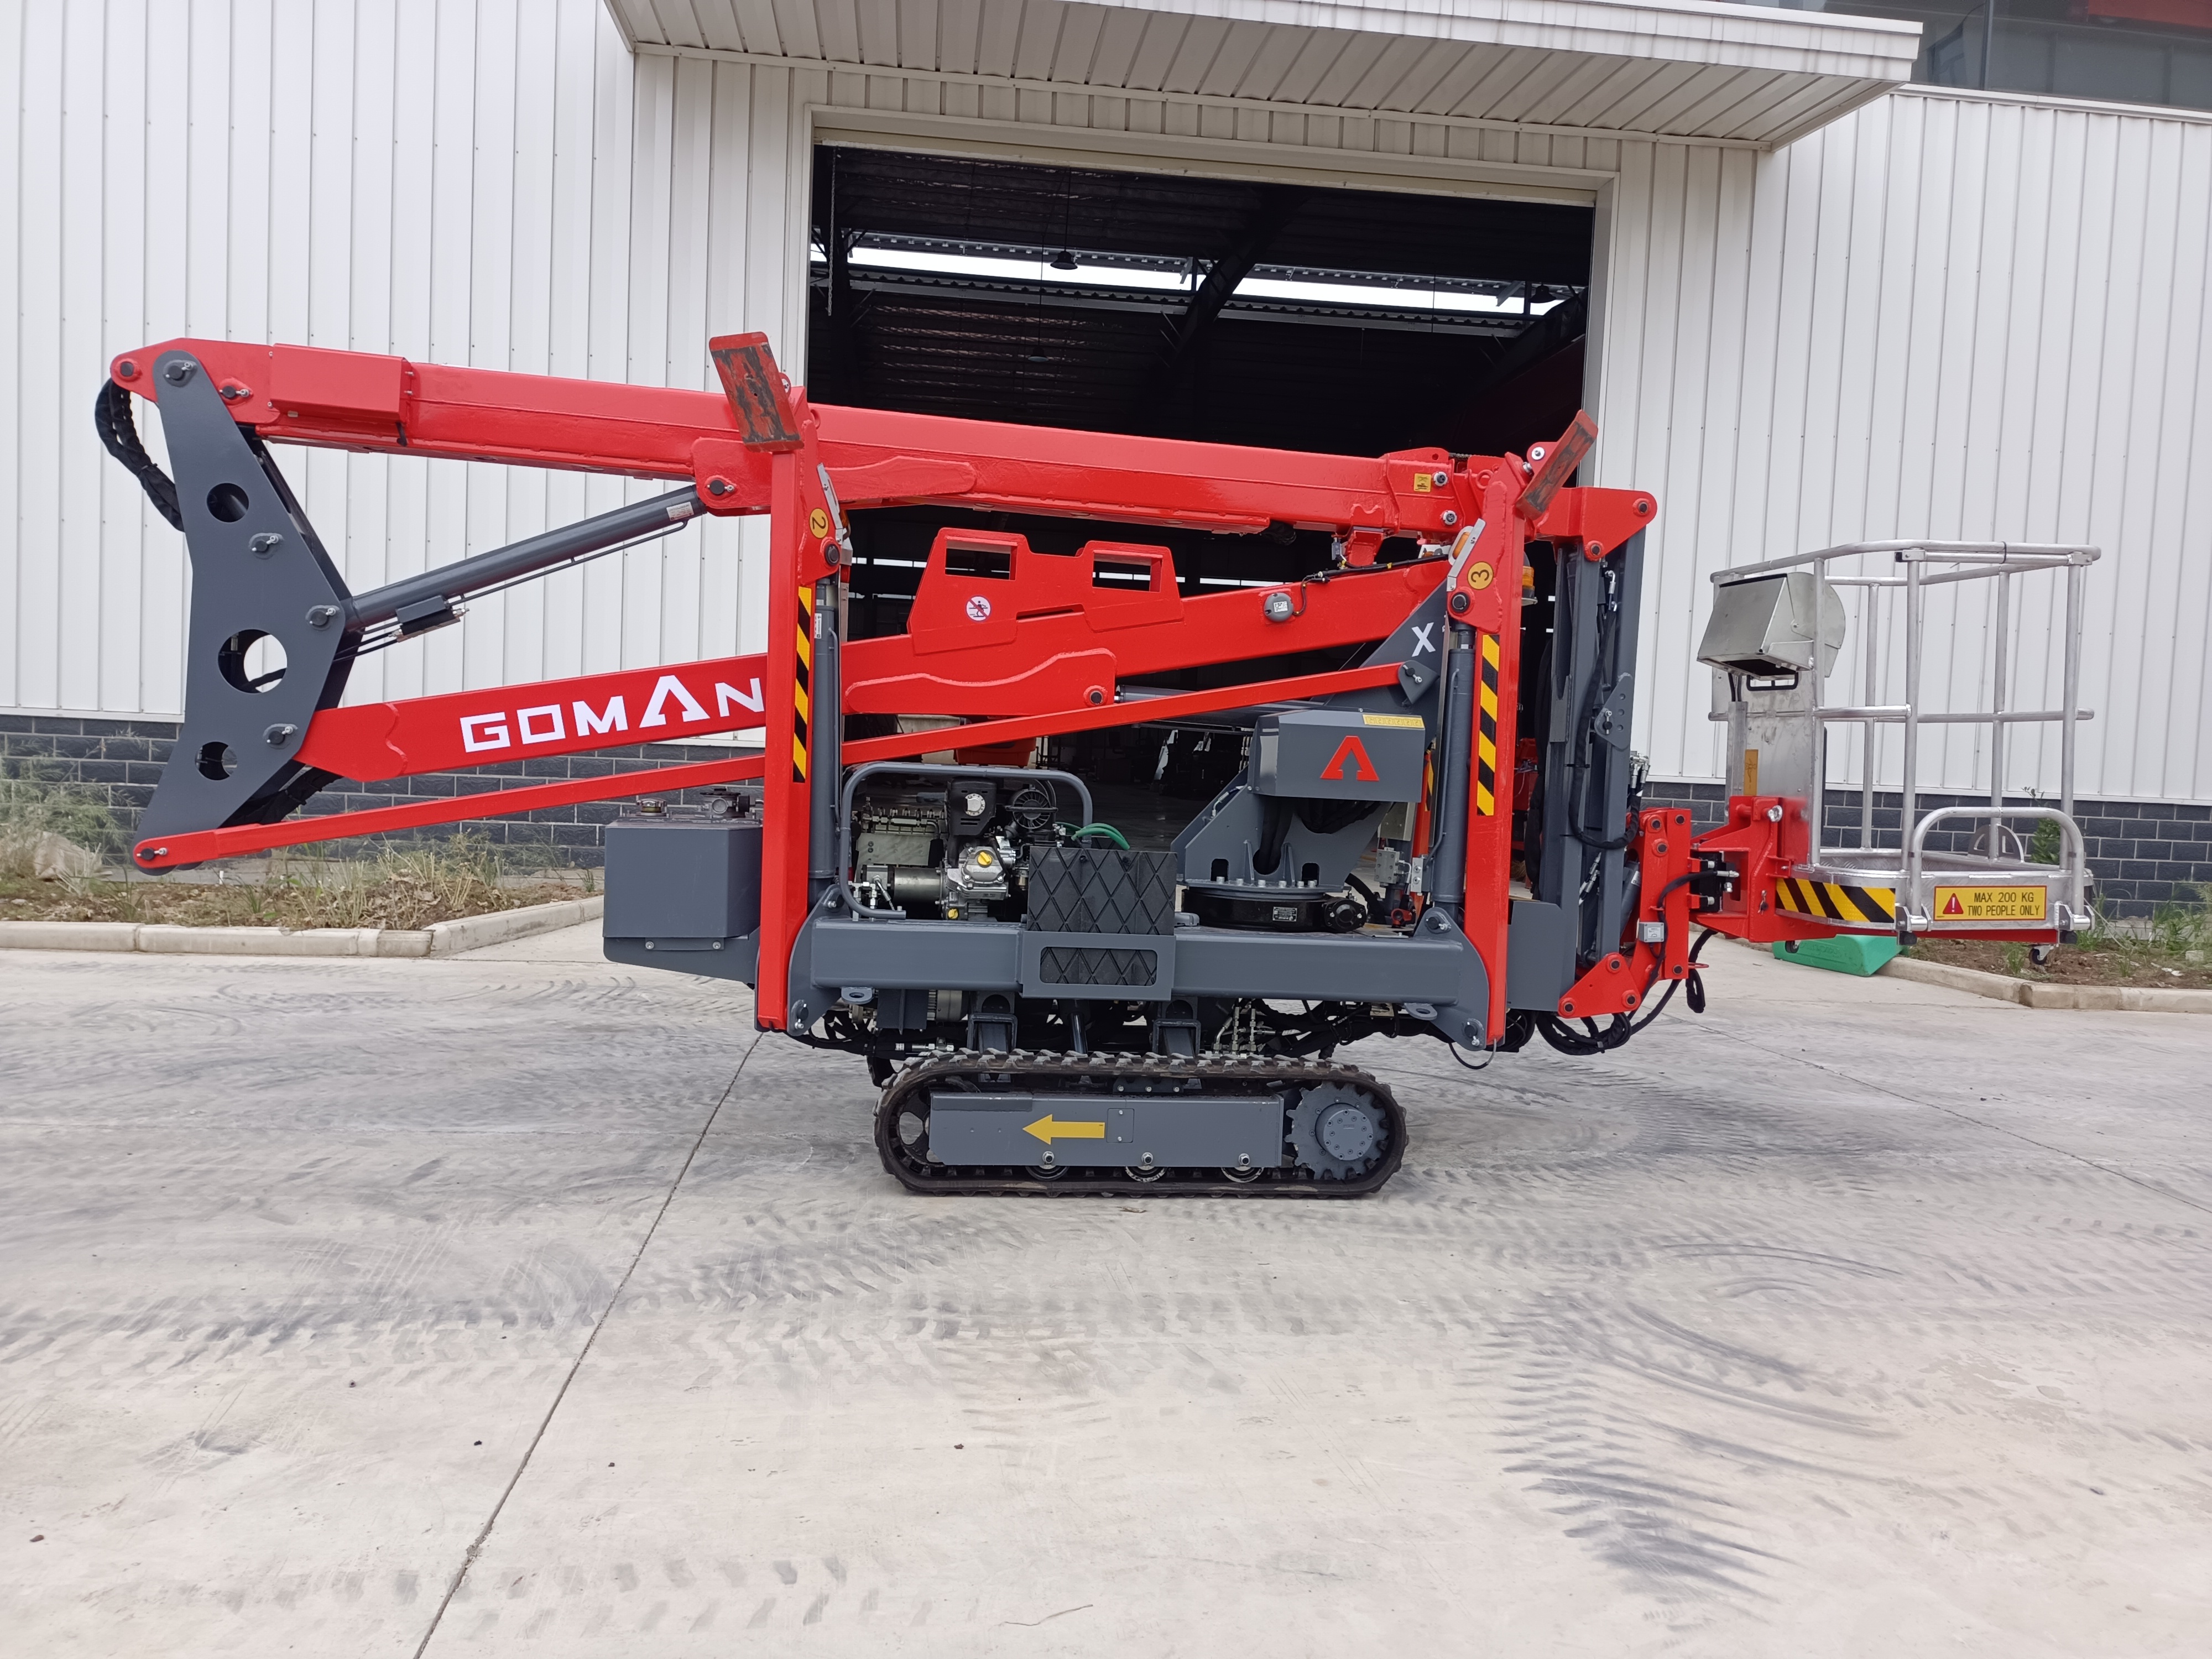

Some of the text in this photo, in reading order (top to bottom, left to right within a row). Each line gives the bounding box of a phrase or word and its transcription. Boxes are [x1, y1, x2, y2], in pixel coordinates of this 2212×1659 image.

[812, 516, 827, 530] 2
[1470, 569, 1490, 583] 3
[1411, 622, 1446, 658] X
[460, 675, 765, 753] GOMAN
[1974, 892, 2034, 902] MAX 200 KG
[1967, 905, 2041, 916] TWO PEOPLE ONLY
